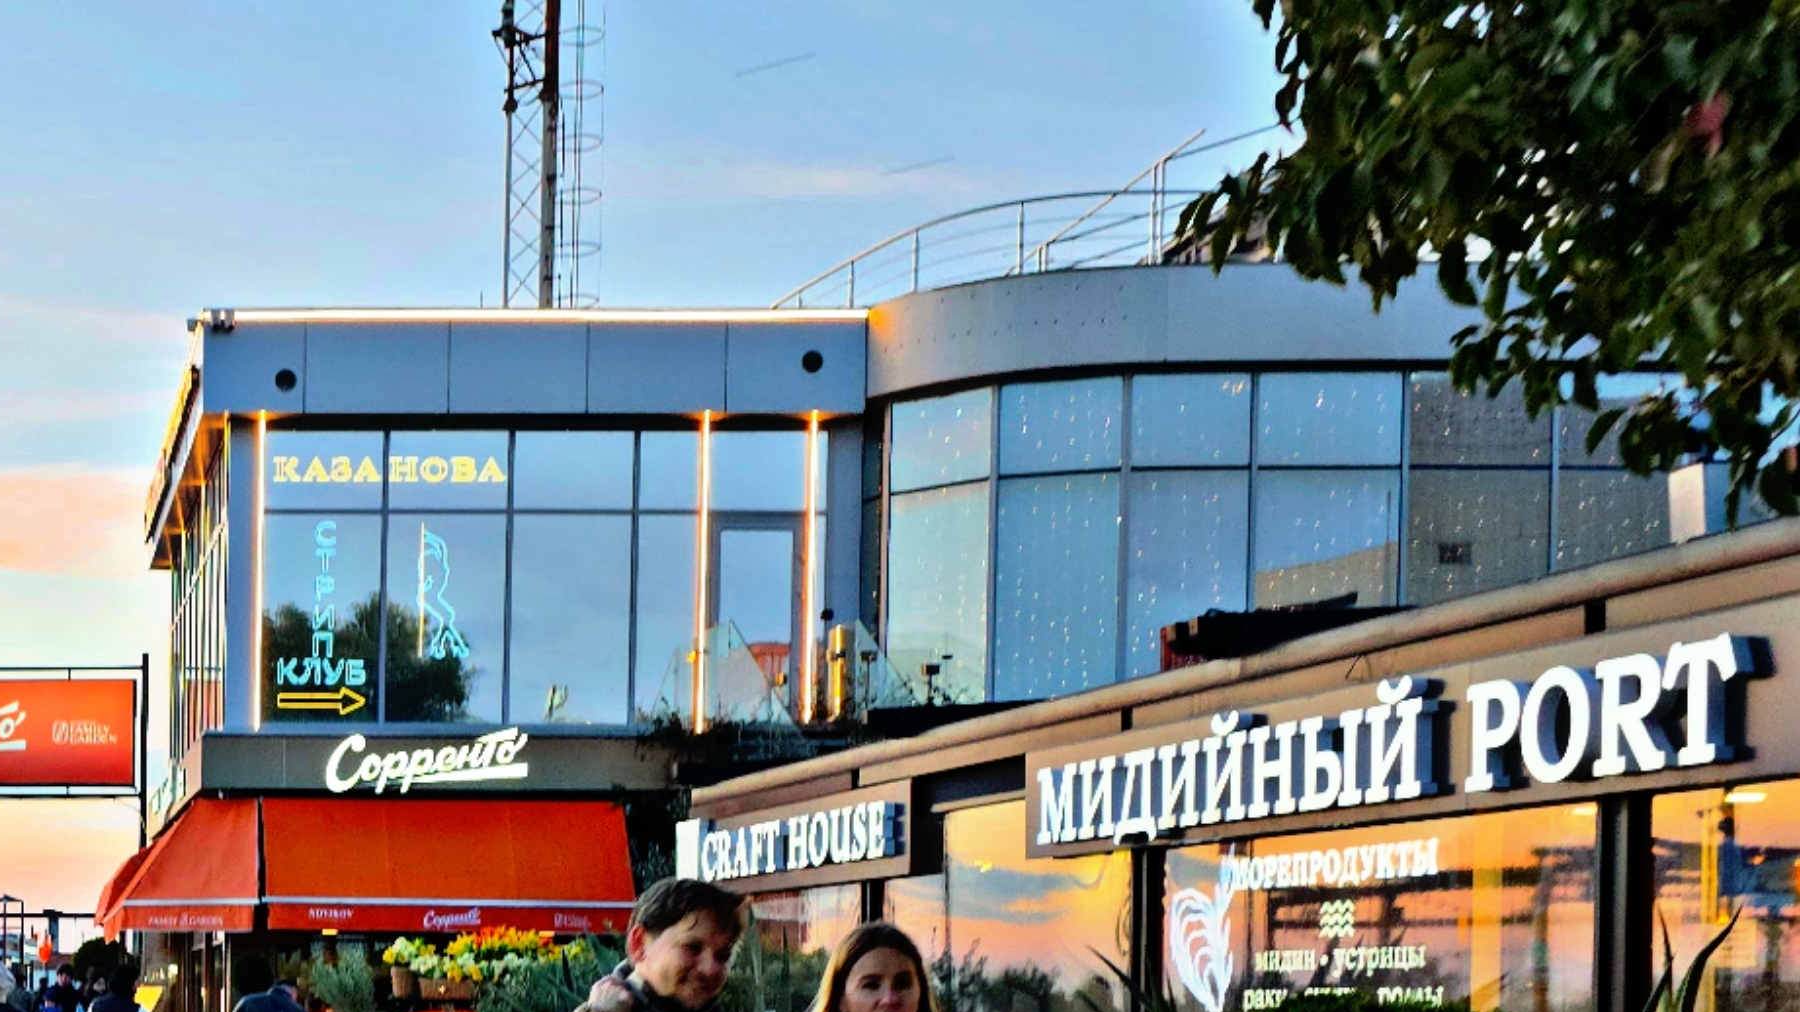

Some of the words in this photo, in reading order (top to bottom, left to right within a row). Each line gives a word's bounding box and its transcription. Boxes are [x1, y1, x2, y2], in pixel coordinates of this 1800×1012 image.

[312, 520, 337, 658] СТРИП
[276, 657, 366, 686] КЛУБ
[325, 727, 528, 794] Сорренто
[1036, 674, 1428, 846] МИДИЙНЫЙ
[1463, 631, 1740, 793] PORT
[701, 819, 780, 882] CRAFT
[786, 800, 886, 871] HOUSE
[1229, 837, 1439, 891] МОРЕПРОДУКТЫ
[1332, 945, 1427, 979] устрицы
